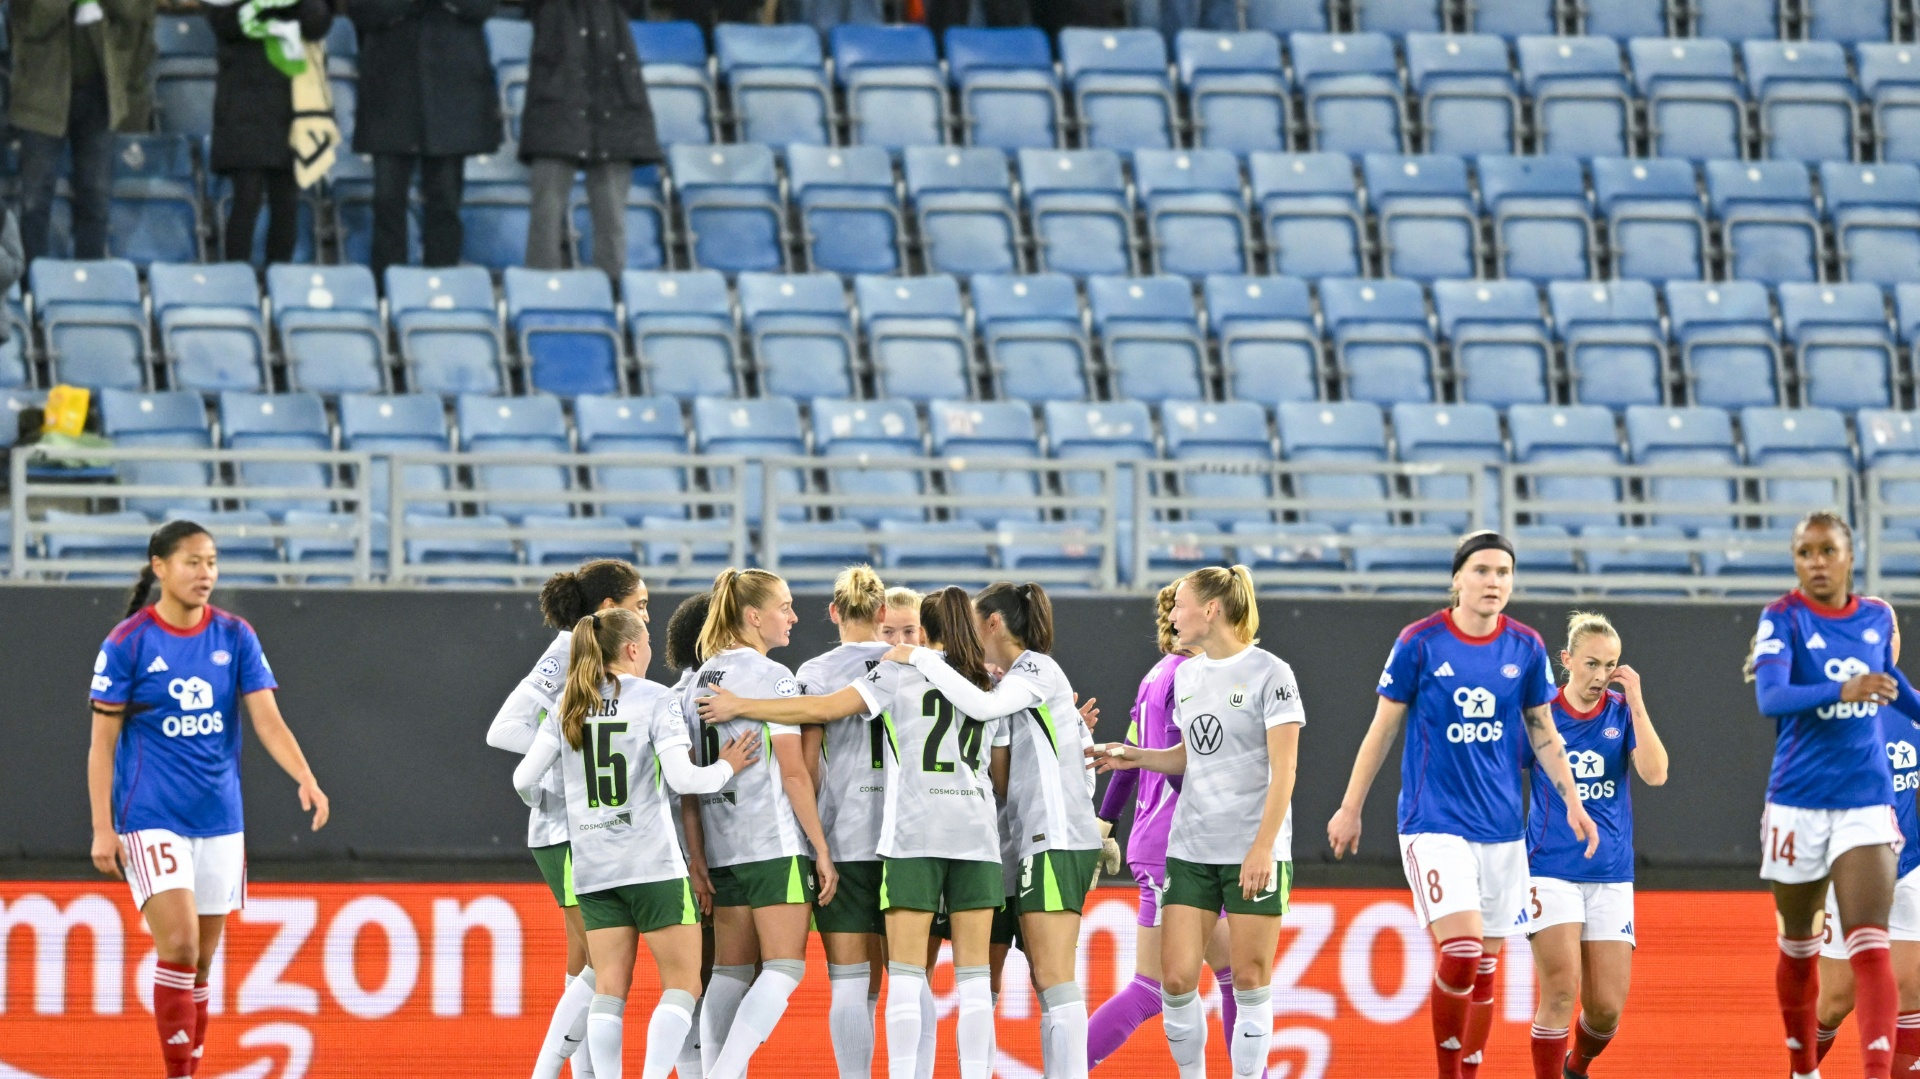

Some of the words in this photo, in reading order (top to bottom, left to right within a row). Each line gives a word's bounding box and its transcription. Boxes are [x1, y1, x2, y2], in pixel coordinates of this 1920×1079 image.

[163, 712, 224, 737] OBOS
[922, 689, 983, 778] 24
[1446, 721, 1503, 744] OBOS
[582, 721, 628, 808] 15
[929, 788, 960, 796] COSMOS
[1577, 780, 1616, 800] BOS
[146, 842, 178, 877] 15
[1772, 827, 1796, 866] 14
[1021, 855, 1034, 888] 3
[1426, 869, 1443, 904] 8
